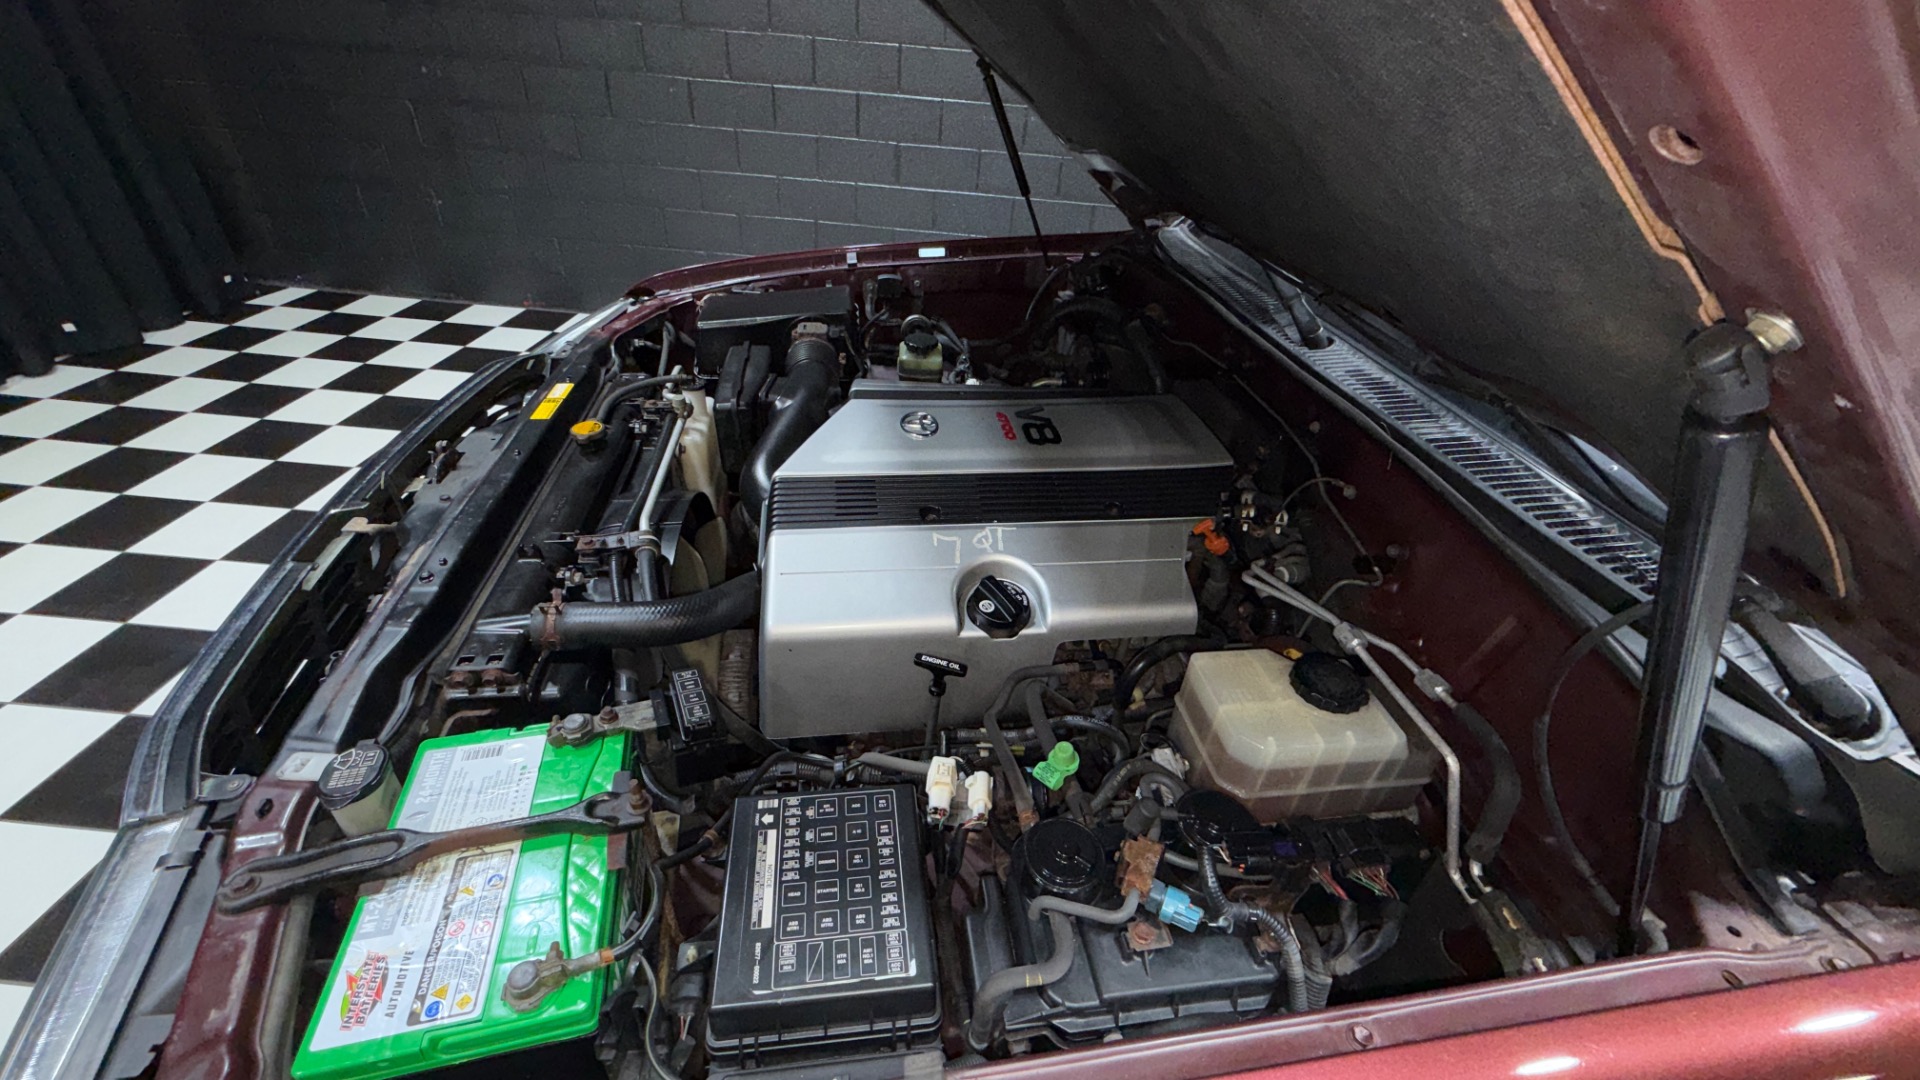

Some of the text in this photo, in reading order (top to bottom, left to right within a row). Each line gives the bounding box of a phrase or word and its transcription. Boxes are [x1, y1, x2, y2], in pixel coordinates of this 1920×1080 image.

[1015, 405, 1062, 445] V8
[921, 655, 961, 671] ENGINE OIL
[415, 751, 447, 804] 24-MONTH
[766, 863, 774, 888] NOTICE
[384, 950, 414, 1018] AUTOMOTIVE
[418, 919, 448, 996] DANGER/POISON
[342, 953, 375, 1029] INTERSTATE
[356, 956, 386, 1024] BATTERIES
